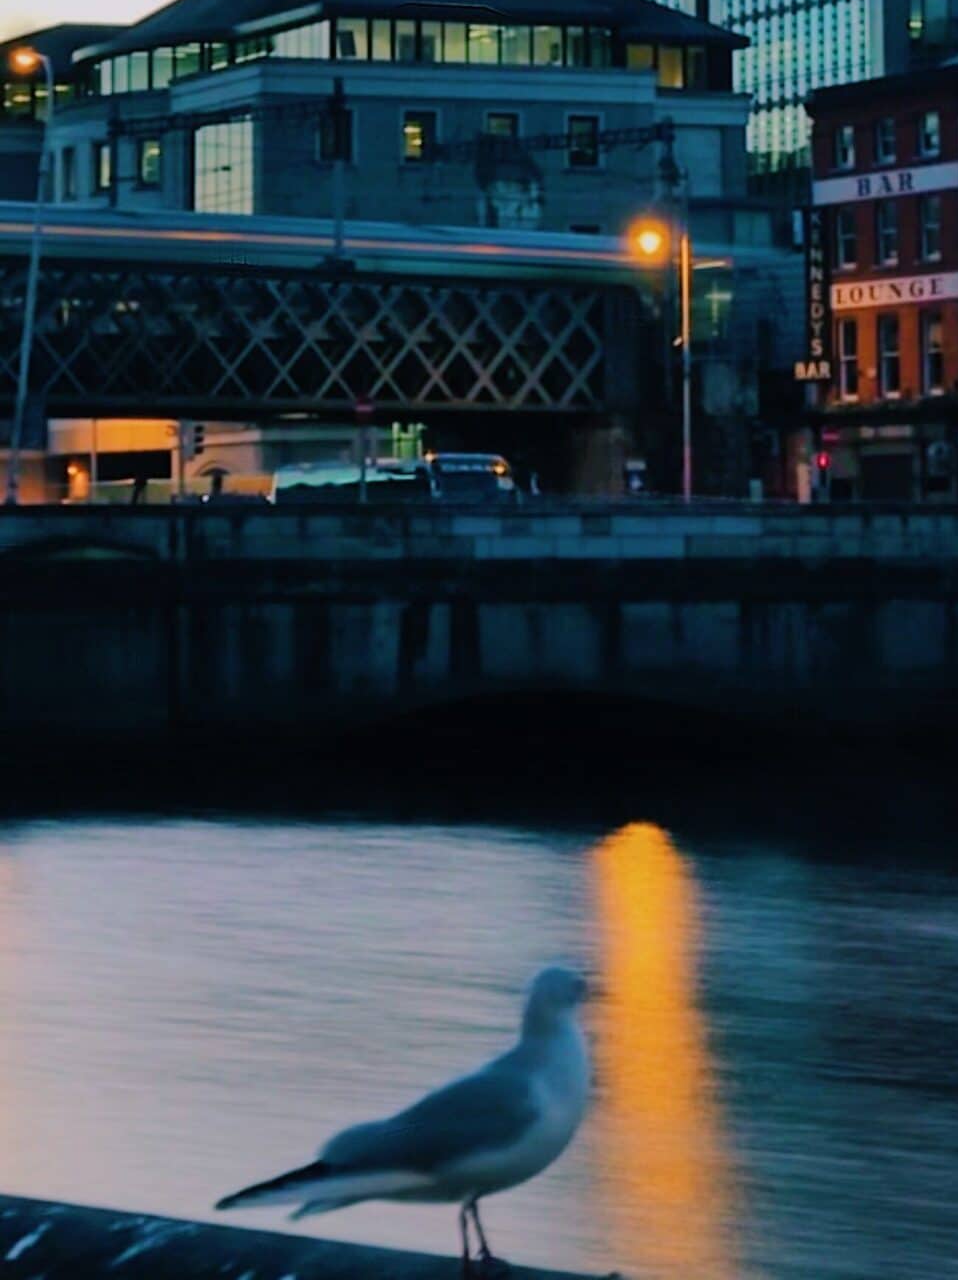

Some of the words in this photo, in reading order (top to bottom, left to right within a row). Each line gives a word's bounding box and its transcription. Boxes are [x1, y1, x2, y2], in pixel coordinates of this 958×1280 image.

[856, 172, 915, 197] BAR
[835, 277, 945, 305] LOUNGE
[794, 360, 831, 380] BAR
